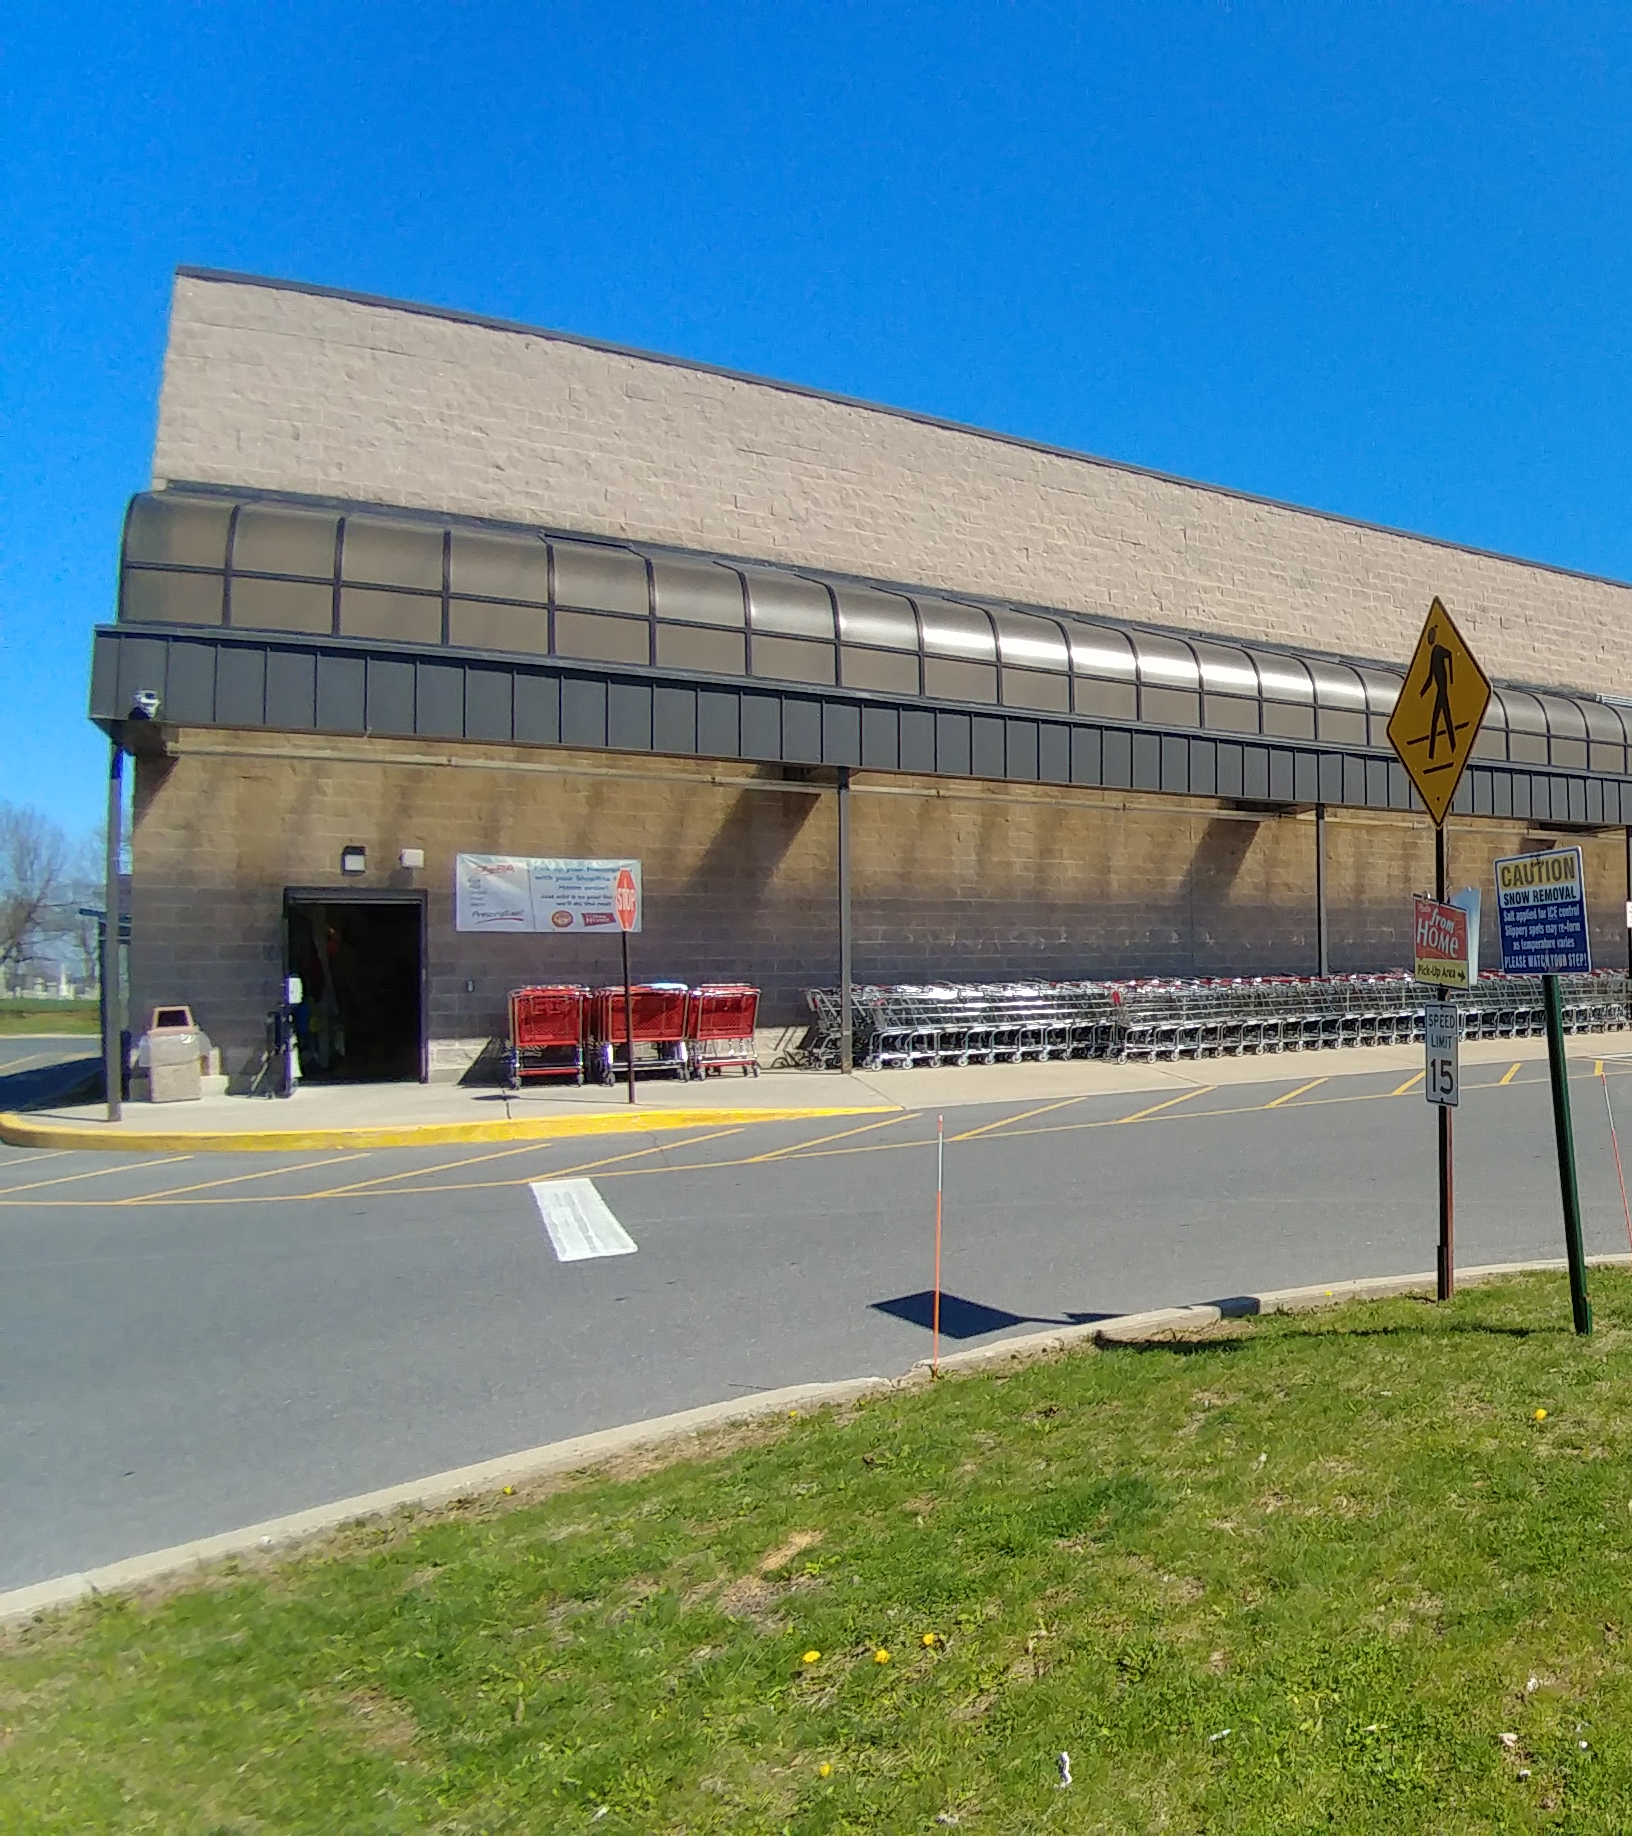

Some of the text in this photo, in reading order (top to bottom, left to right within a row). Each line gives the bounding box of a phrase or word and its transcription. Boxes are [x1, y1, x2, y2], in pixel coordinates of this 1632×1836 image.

[1500, 856, 1576, 888] CAUTION
[616, 888, 635, 911] STOP
[1503, 886, 1577, 906] SNOW REMOVAL
[1429, 908, 1455, 934] from
[1516, 907, 1537, 923] applied
[1538, 907, 1547, 920] for
[1547, 906, 1558, 919] ICE
[1558, 904, 1580, 917] control
[1504, 920, 1581, 939] Slippery spots may re-form
[1512, 936, 1575, 952] as temperature varies
[1504, 952, 1588, 969] PLEASE WATCH YOUR STEP!
[1417, 964, 1456, 979] Pick-Up Area
[1428, 1013, 1455, 1029] SPEED
[1430, 1034, 1452, 1050] LIMIT
[1430, 1057, 1453, 1095] 15
